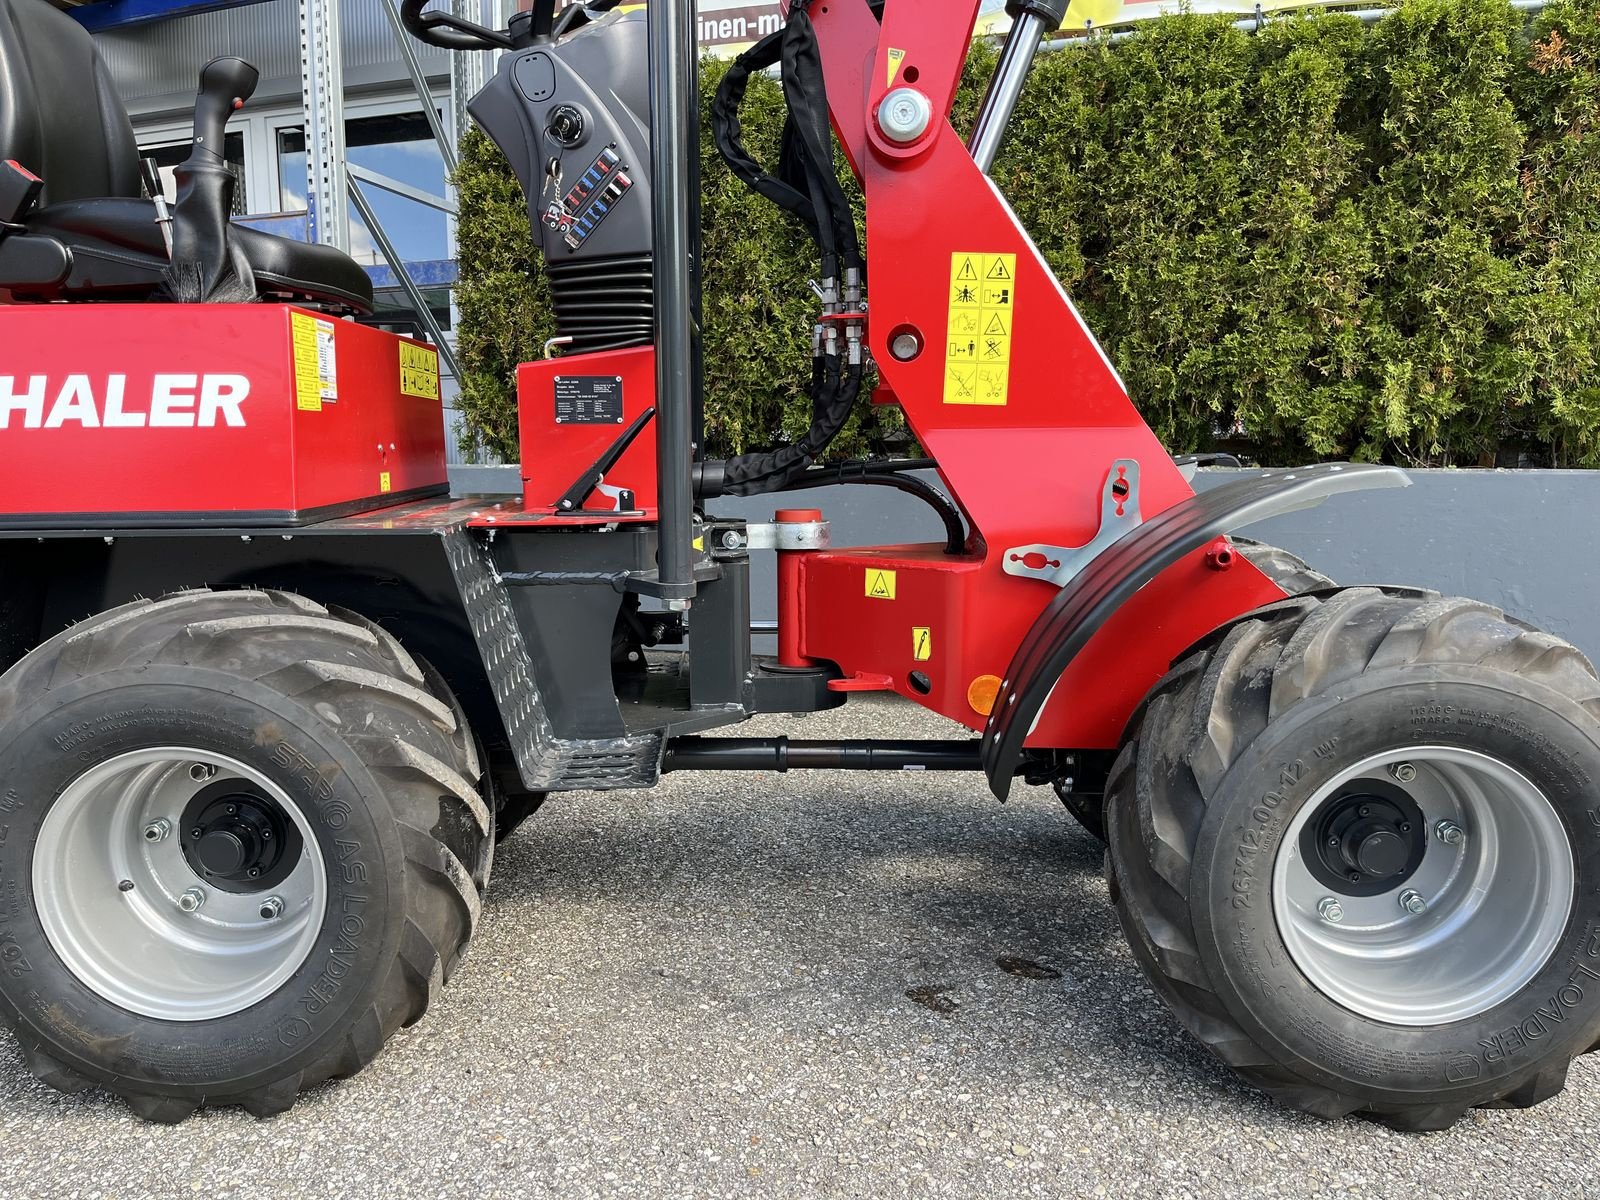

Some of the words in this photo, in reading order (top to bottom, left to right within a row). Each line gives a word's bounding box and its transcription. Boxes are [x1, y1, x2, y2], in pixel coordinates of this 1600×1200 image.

[0, 374, 250, 428] HALER
[335, 839, 368, 885] AS
[301, 894, 368, 1015] LOADER
[1478, 963, 1600, 1064] LOADER
